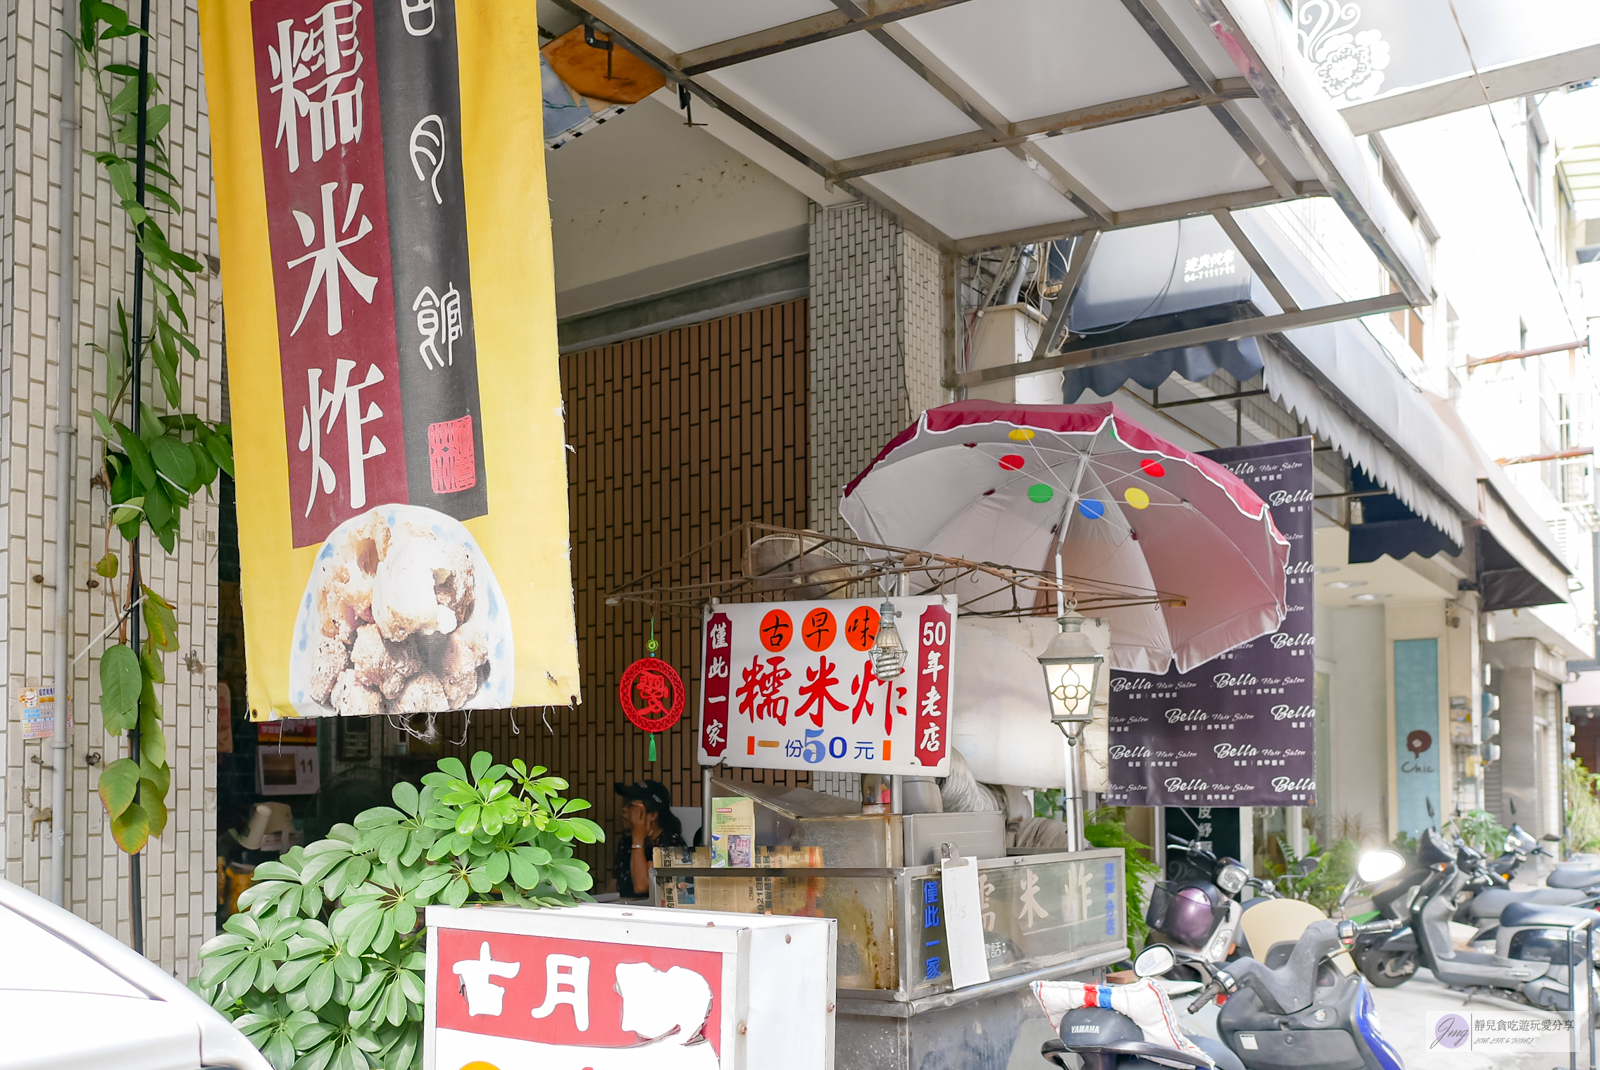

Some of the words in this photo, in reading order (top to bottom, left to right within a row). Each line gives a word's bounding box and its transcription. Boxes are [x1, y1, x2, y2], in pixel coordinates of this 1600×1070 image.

[268, 0, 387, 518] 糯米炸
[1259, 464, 1279, 473] Hair
[1280, 461, 1303, 472] Salon
[1268, 489, 1314, 507] Bella
[1285, 561, 1314, 575] ella
[761, 608, 876, 649] 古早味
[1270, 632, 1315, 649] Bella
[705, 622, 729, 748] 僅此一家
[919, 621, 947, 752] 50年老店
[1110, 677, 1153, 693] Bella
[1174, 681, 1198, 690] Salon
[1213, 672, 1259, 688] Bella
[1261, 677, 1280, 685] Hair
[1282, 676, 1306, 686] Salon
[735, 654, 908, 736] 糯米炸
[1126, 716, 1149, 724] Salon
[1165, 708, 1209, 724] Bella
[1231, 713, 1254, 722] Salon
[1271, 704, 1315, 721] Bella
[757, 728, 875, 764] 一份50元
[1109, 745, 1152, 760] Bella
[1174, 750, 1198, 760] Salon
[1214, 743, 1260, 759] Bella
[1262, 749, 1281, 757] Hair
[1282, 748, 1306, 758] Salon
[300, 758, 314, 773] 11
[1401, 761, 1435, 774] Chic
[1126, 784, 1148, 792] Salon
[1164, 777, 1210, 792] Bella
[1212, 784, 1231, 792] Hair
[1231, 784, 1254, 793] Salon
[1271, 776, 1316, 792] Bella
[923, 880, 942, 980] 僅此一家
[1071, 1025, 1100, 1034] YAMAHA
